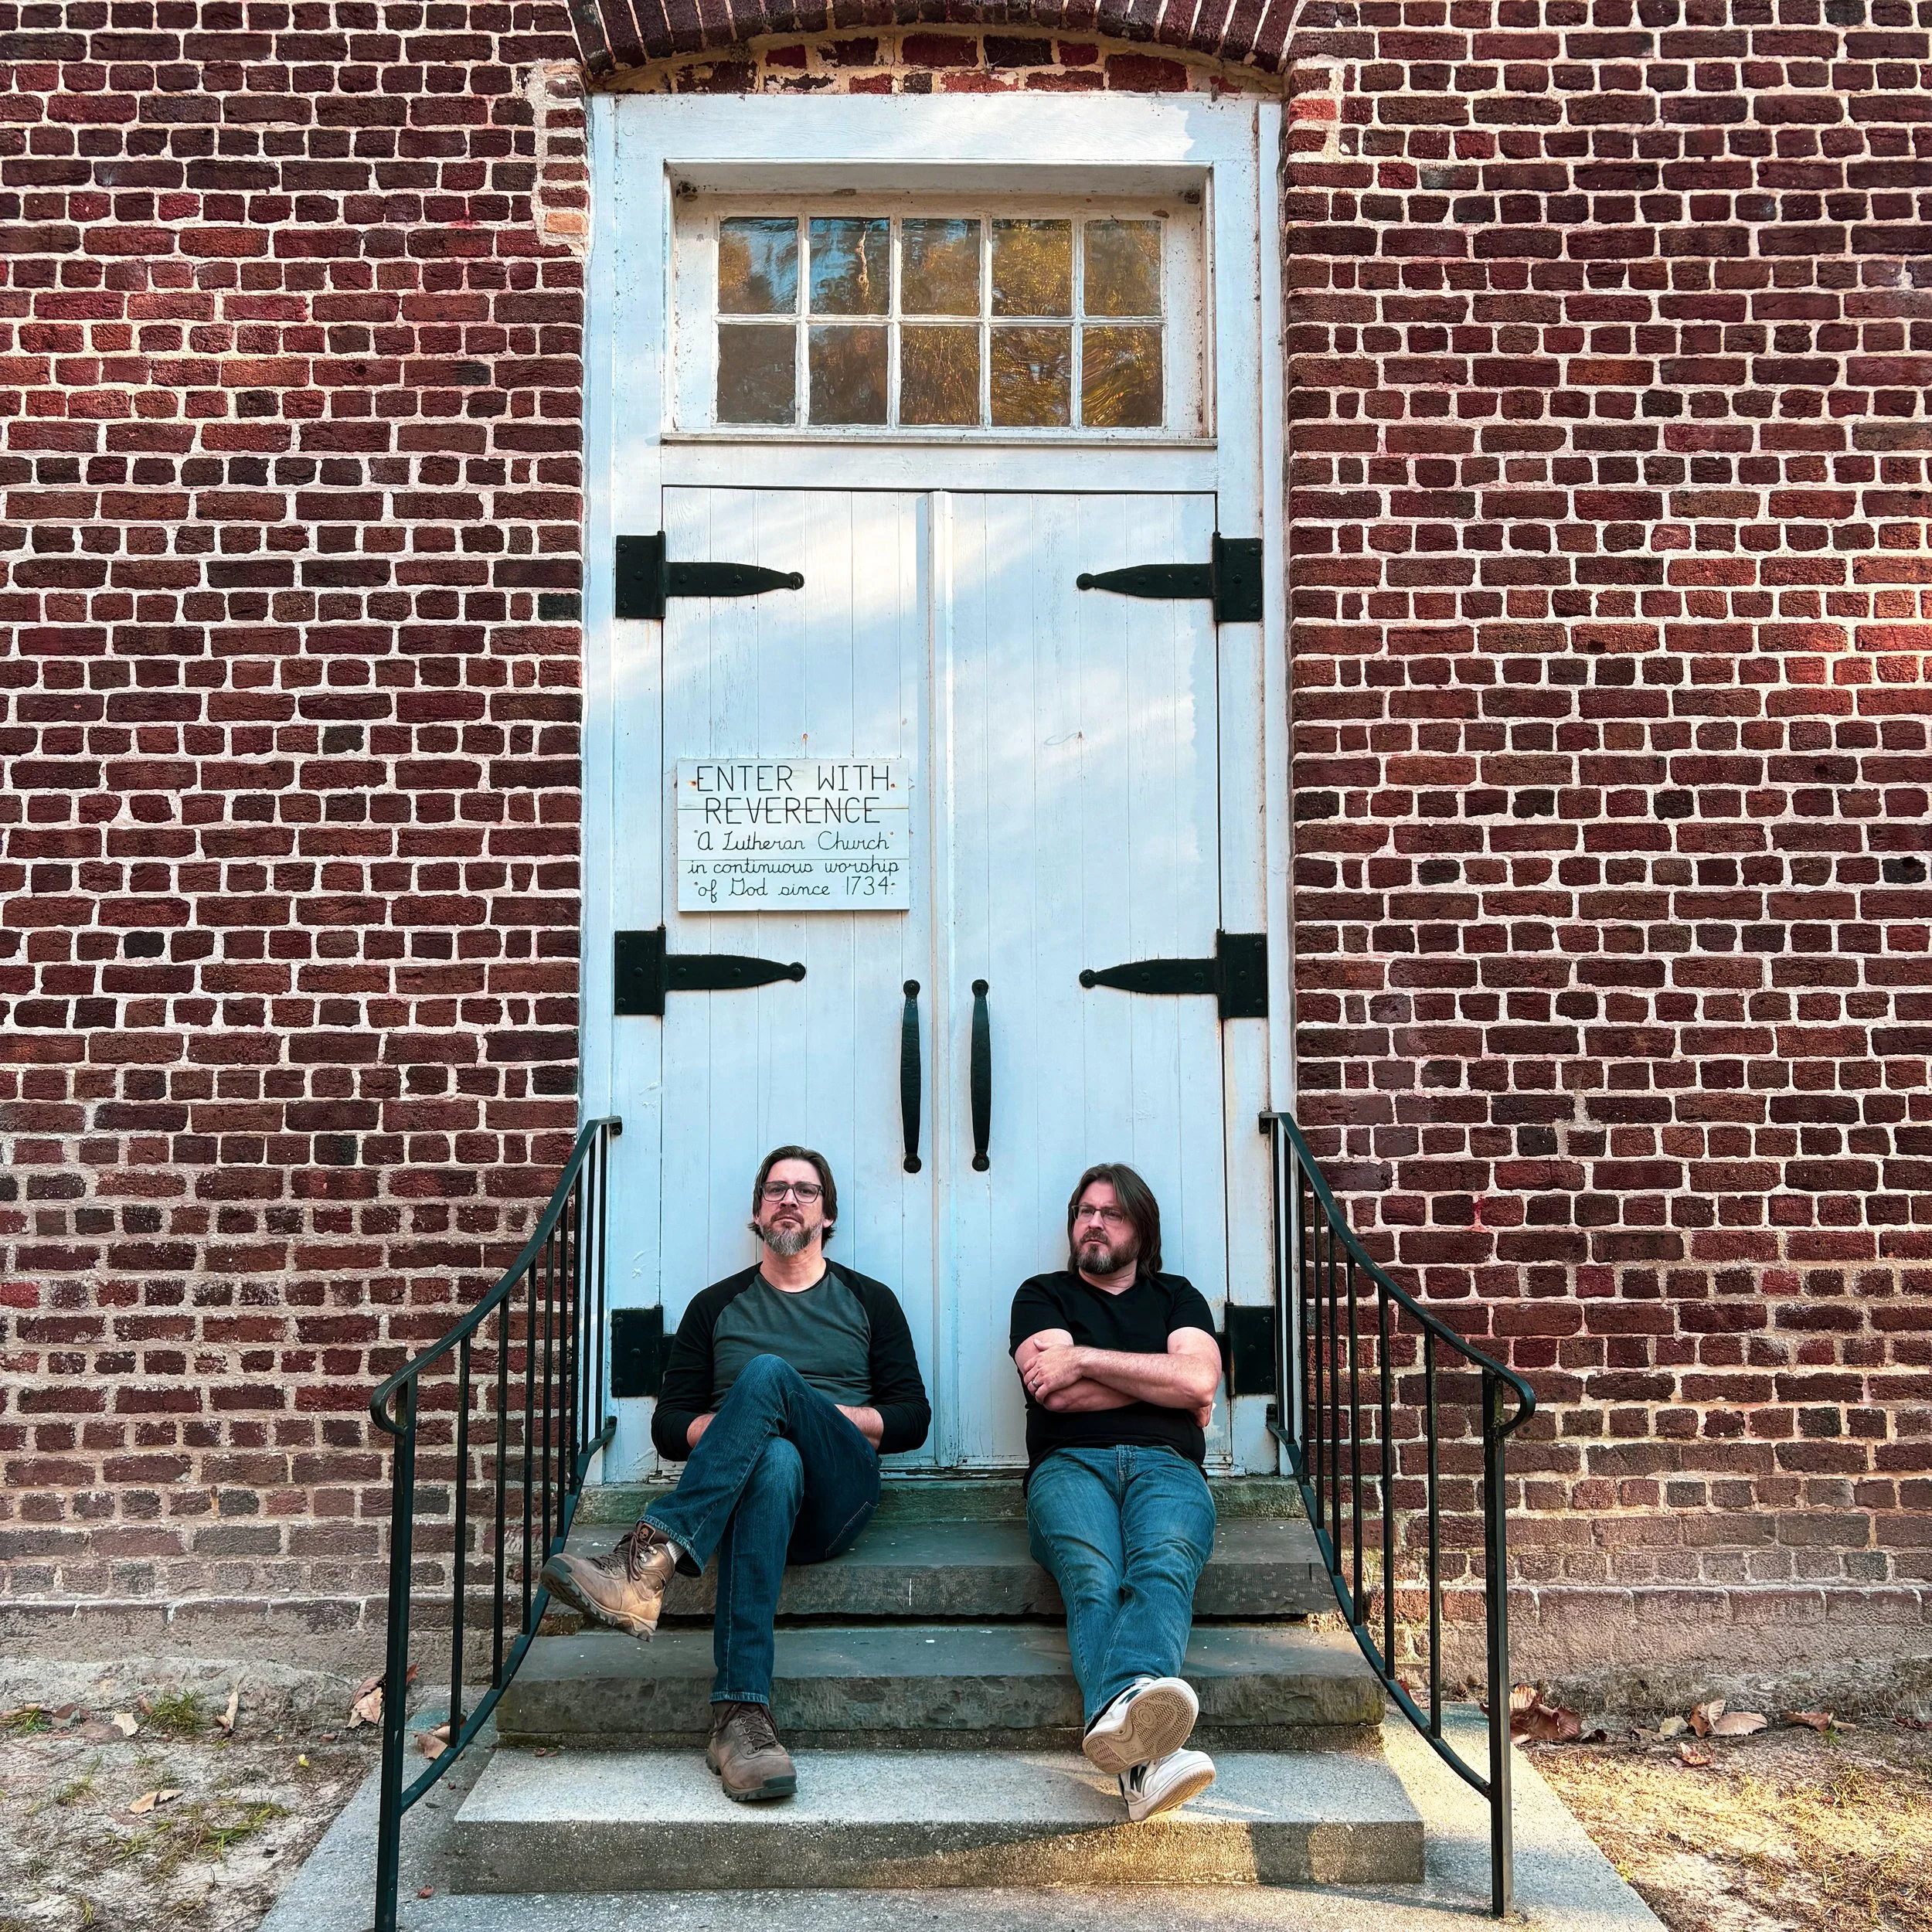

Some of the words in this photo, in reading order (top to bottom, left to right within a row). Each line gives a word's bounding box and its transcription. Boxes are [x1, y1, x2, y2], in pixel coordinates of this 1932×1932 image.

[697, 765, 792, 791] ENTER
[818, 765, 889, 791] WITH
[706, 798, 880, 824] REVERENCE
[698, 832, 713, 850] A
[723, 831, 805, 850] Lutheran
[818, 831, 889, 850] Church
[688, 860, 707, 874] in
[713, 857, 813, 873] continuous
[825, 855, 899, 876] worship
[698, 879, 717, 903] of
[729, 878, 768, 896] God
[778, 883, 830, 895] since
